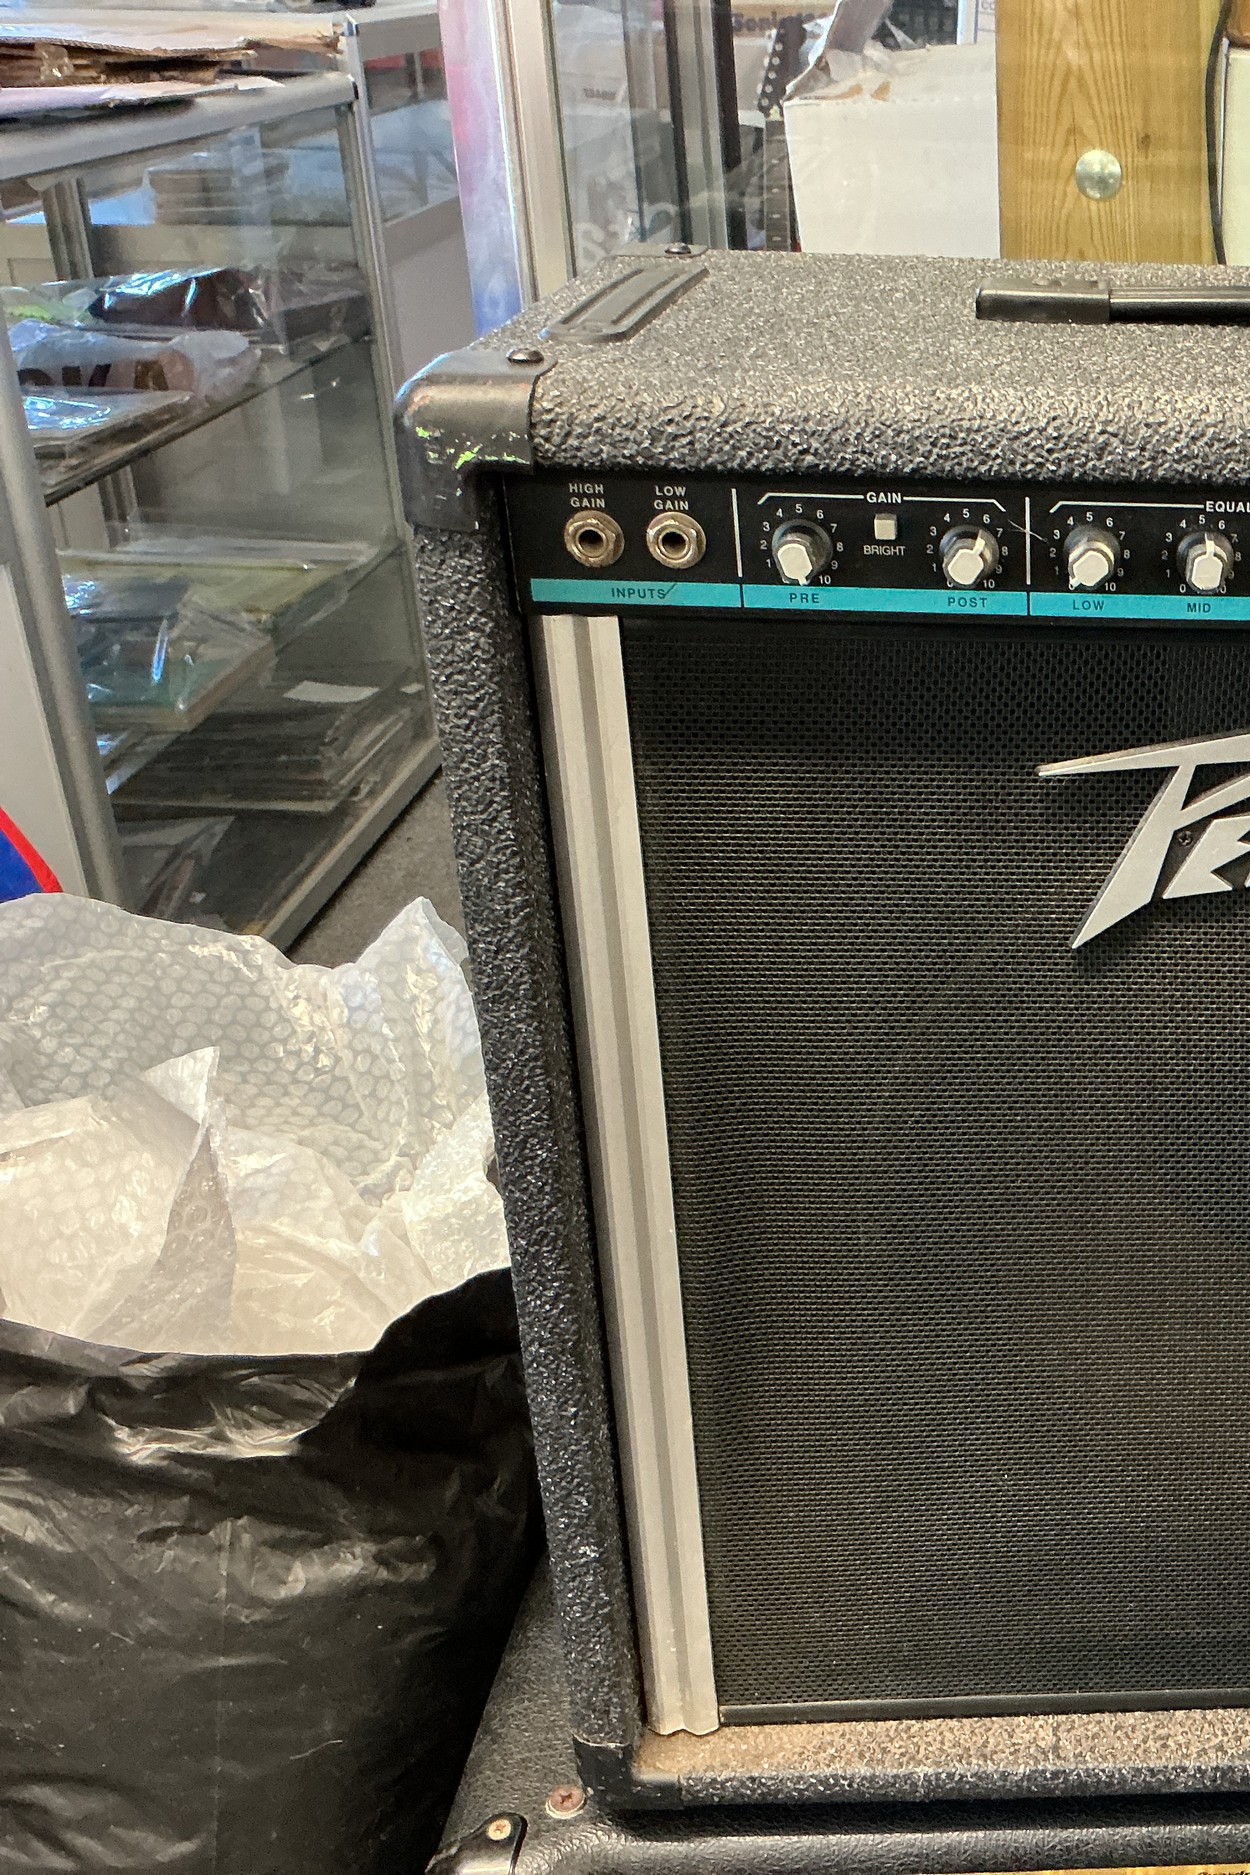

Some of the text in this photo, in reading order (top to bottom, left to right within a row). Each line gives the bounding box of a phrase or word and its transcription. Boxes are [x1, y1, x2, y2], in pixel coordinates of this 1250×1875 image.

[569, 484, 604, 495] HIGH
[655, 486, 687, 496] LOW
[570, 498, 606, 509] GAIN
[866, 492, 902, 504] GAIN
[653, 500, 689, 511] GAIN
[943, 512, 951, 523] 4
[962, 508, 970, 518] 5
[983, 513, 991, 524] 6
[1086, 511, 1093, 522] 5
[1067, 516, 1074, 526] 4
[1106, 517, 1114, 528] 6
[1180, 518, 1187, 529] 4
[1198, 514, 1206, 524] 5
[1218, 520, 1226, 530] 6
[929, 526, 937, 536] 3
[996, 527, 1003, 538] 7
[1053, 529, 1060, 540] 3
[1118, 530, 1126, 540] 7
[1165, 532, 1173, 543] 3
[1230, 533, 1238, 543] 7
[760, 503, 844, 585] 1 2 3 4 5 6 7 8 9 10
[926, 544, 934, 554] 2
[863, 545, 905, 556] BRIGHT
[1001, 545, 1009, 556] 8
[1049, 547, 1057, 558] 2
[1123, 549, 1130, 559] 8
[1161, 550, 1168, 560] 2
[1235, 551, 1242, 562] 8
[932, 562, 937, 572] 1
[1054, 565, 1059, 575] 1
[1117, 567, 1124, 577] 9
[1165, 569, 1171, 578] 1
[983, 579, 995, 589] 10
[1104, 582, 1117, 592] 10
[1179, 583, 1187, 593] 0
[611, 587, 666, 600] INPUTS
[789, 592, 820, 604] PRE
[948, 596, 988, 608] POST
[1072, 600, 1105, 611] LOW
[1187, 602, 1211, 613] MID
